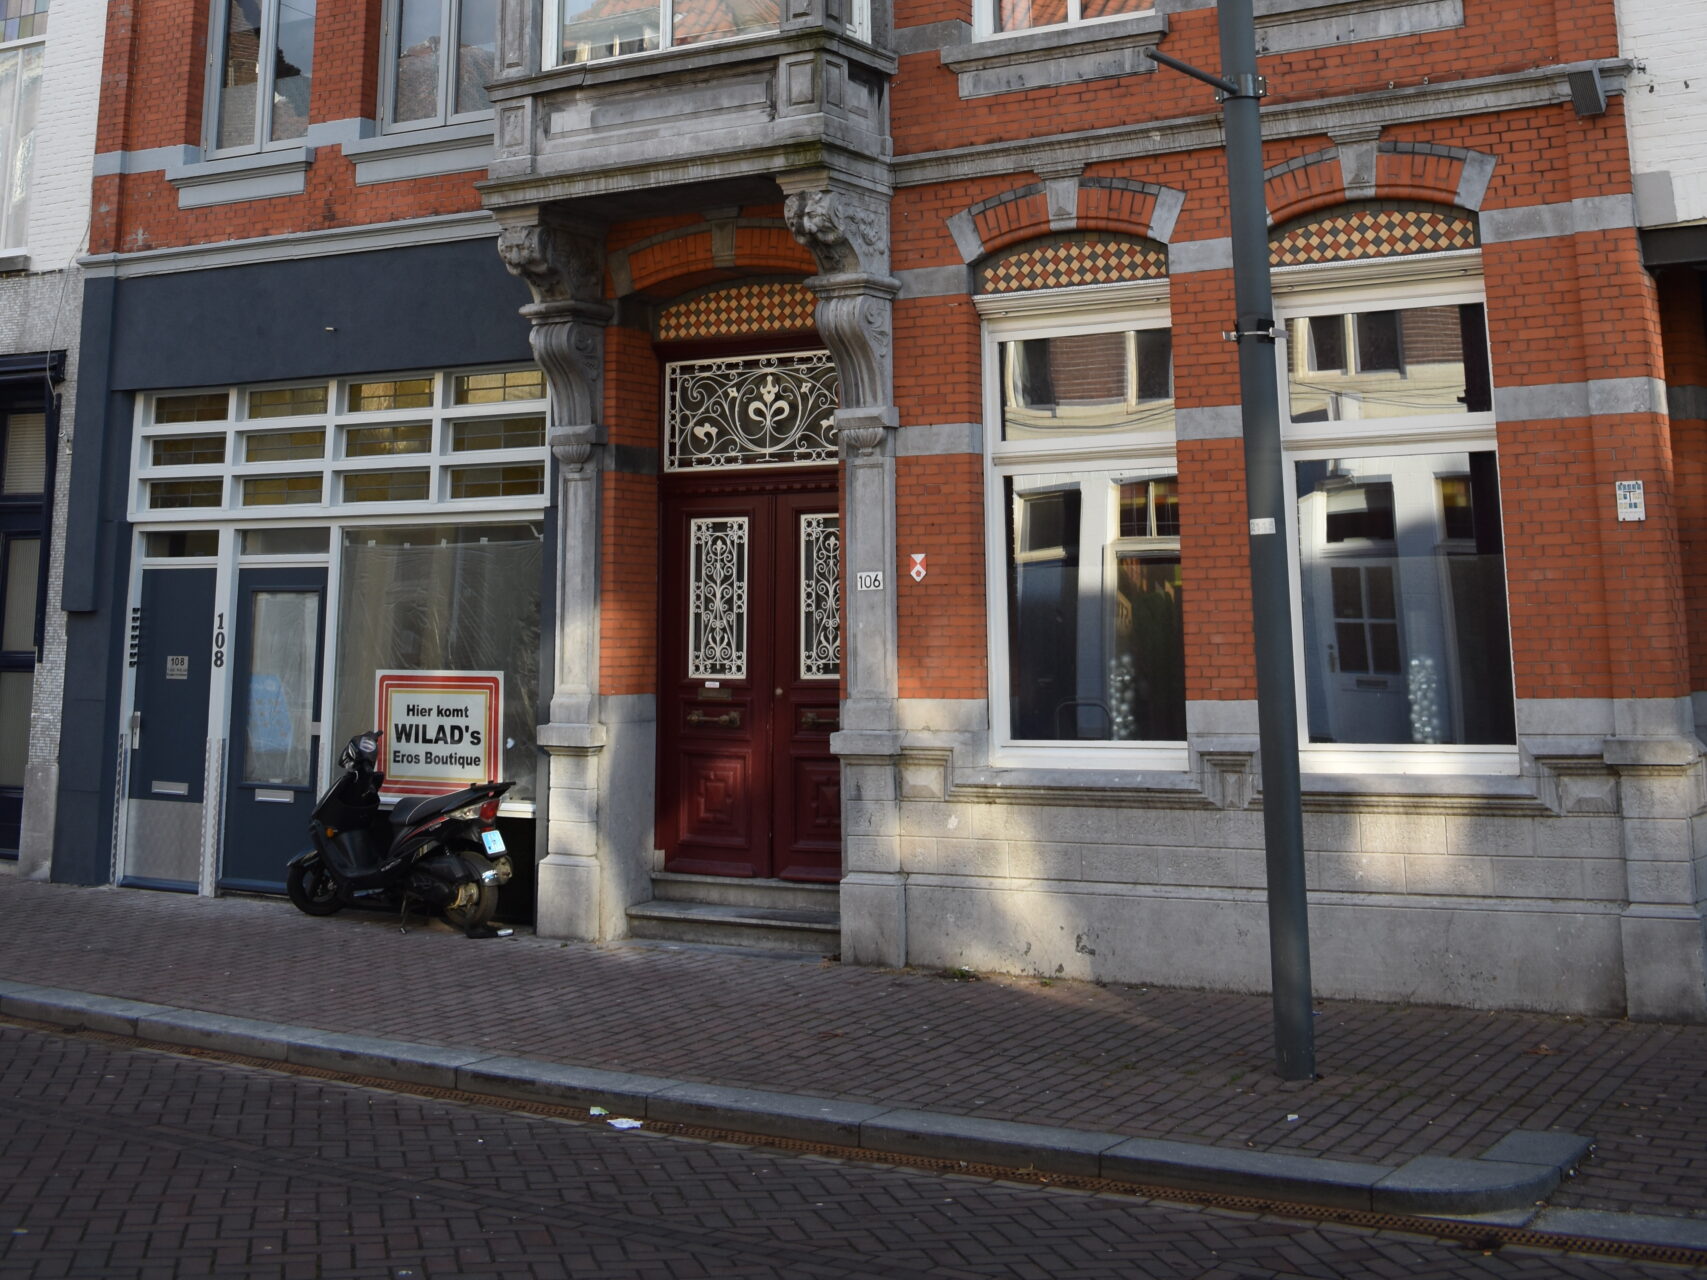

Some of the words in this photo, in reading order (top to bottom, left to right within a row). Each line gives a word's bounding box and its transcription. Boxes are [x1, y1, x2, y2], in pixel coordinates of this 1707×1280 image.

[859, 574, 881, 589] 106
[213, 612, 226, 668] 108
[171, 657, 185, 666] 108
[406, 704, 433, 717] Hier
[436, 705, 469, 718] komt
[394, 723, 482, 746] WILAD's
[393, 750, 420, 764] Eros
[424, 751, 481, 769] Boutique
